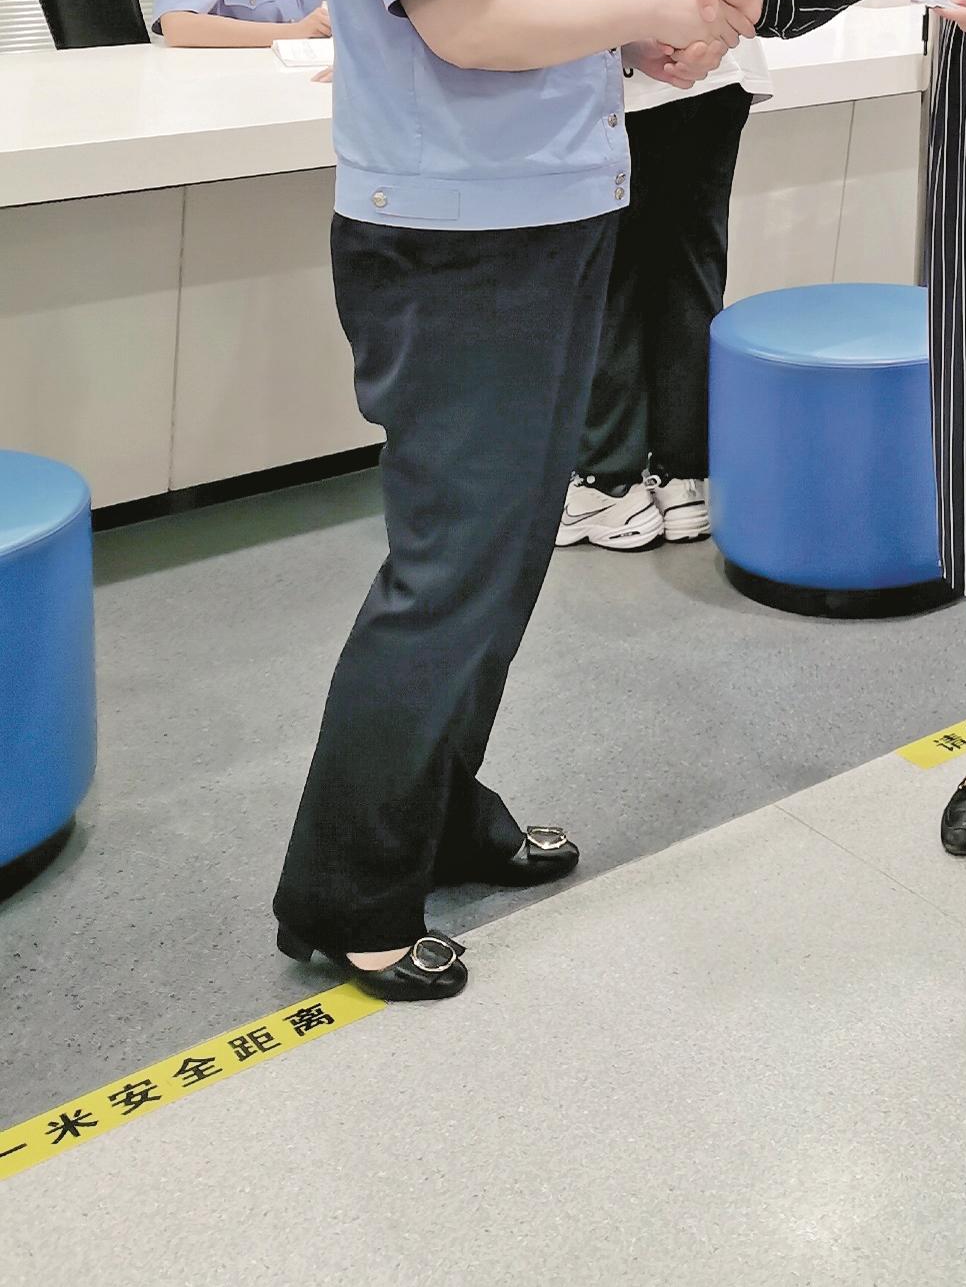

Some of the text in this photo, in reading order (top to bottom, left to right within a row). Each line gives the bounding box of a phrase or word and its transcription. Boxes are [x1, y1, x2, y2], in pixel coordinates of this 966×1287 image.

[0, 1002, 335, 1158] 一米安全距离
